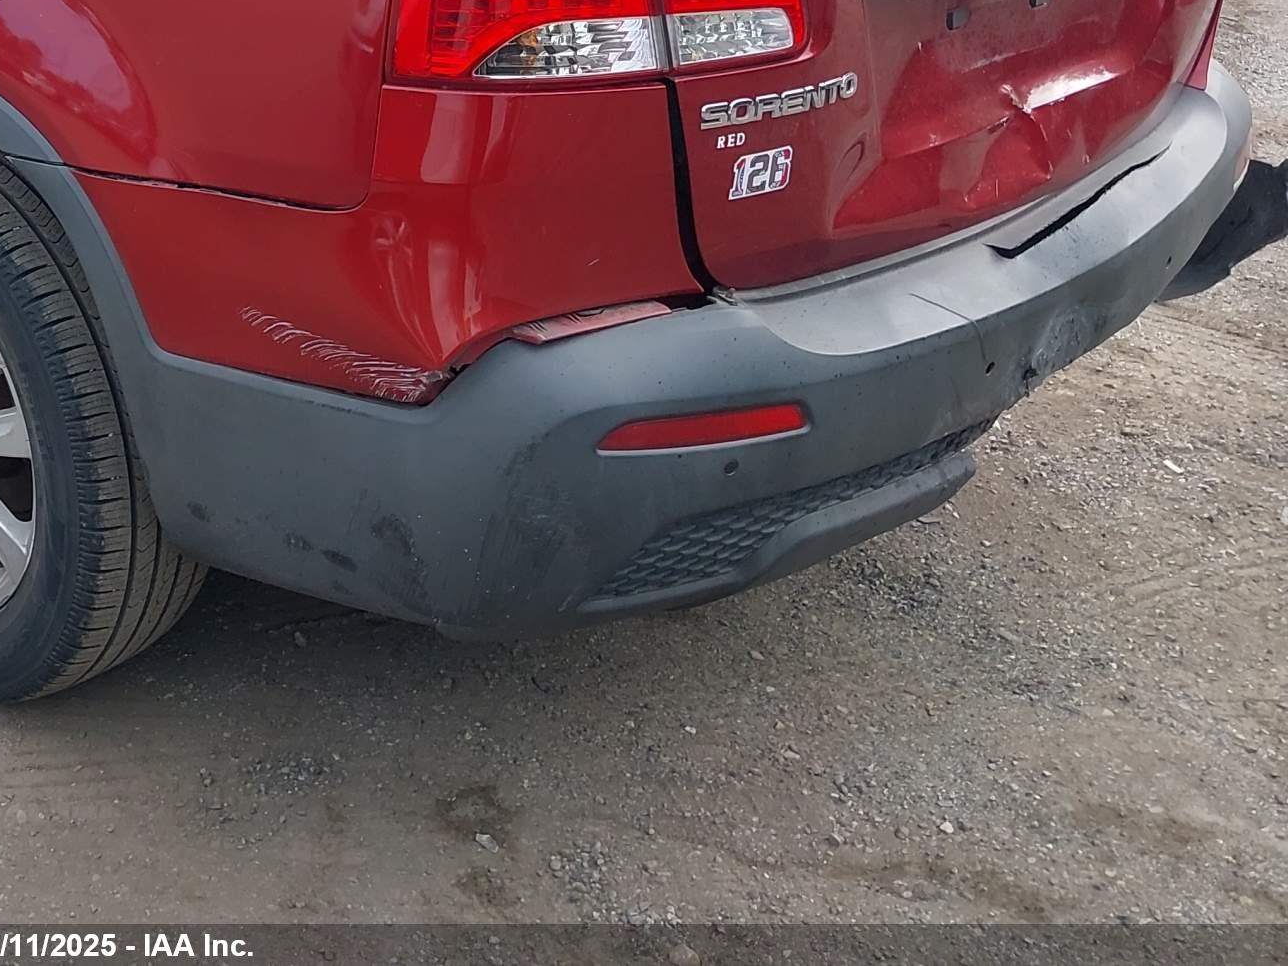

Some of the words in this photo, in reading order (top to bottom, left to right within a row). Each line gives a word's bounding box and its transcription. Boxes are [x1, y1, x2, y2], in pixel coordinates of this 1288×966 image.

[700, 71, 858, 130] SORENTO
[716, 132, 746, 149] RED
[728, 145, 793, 201] 126
